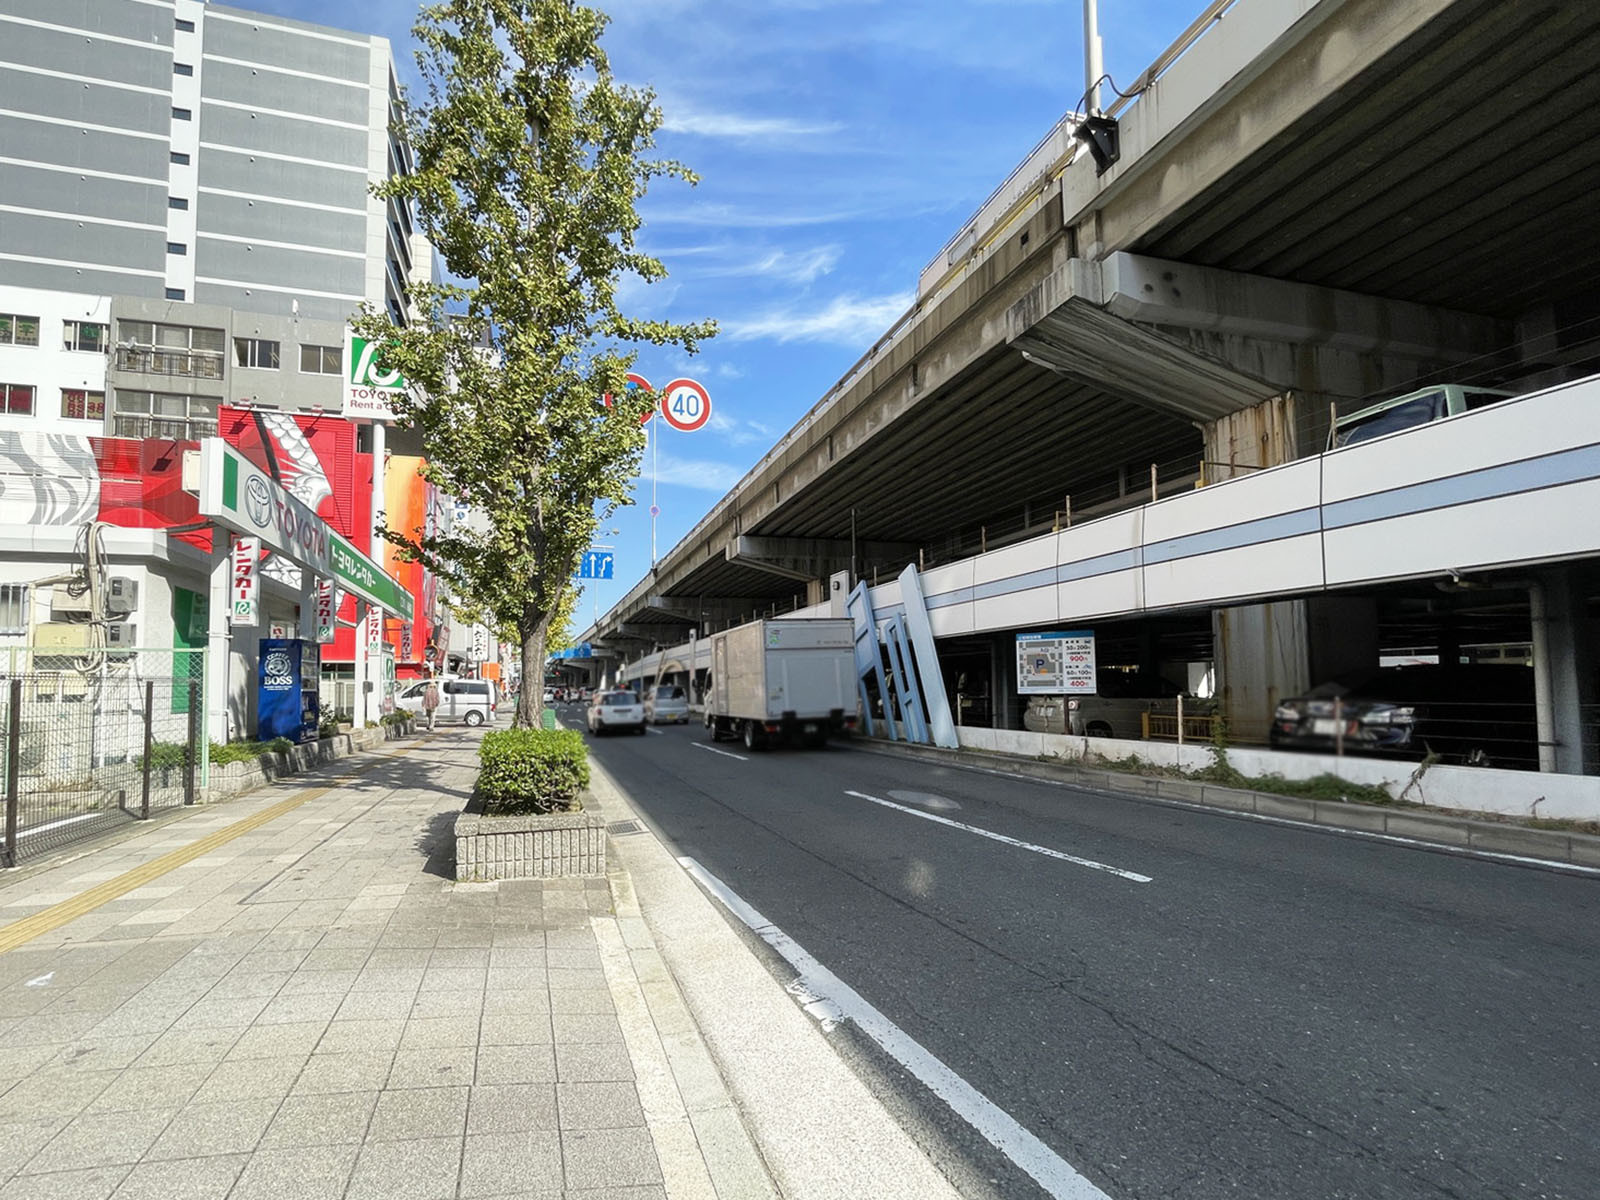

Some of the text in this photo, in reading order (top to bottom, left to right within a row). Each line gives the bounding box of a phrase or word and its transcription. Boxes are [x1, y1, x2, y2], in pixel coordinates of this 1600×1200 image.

[350, 399, 374, 410] Rent
[351, 388, 401, 400] TOYOT
[673, 394, 699, 417] 40
[275, 500, 326, 561] TOYOTA
[235, 541, 252, 600] レンタカー
[331, 544, 376, 588] トヨタレンタカー
[318, 582, 331, 626] レンタカー
[370, 608, 379, 642] レンタカー
[1036, 659, 1045, 669] P
[264, 675, 293, 686] BOSS
